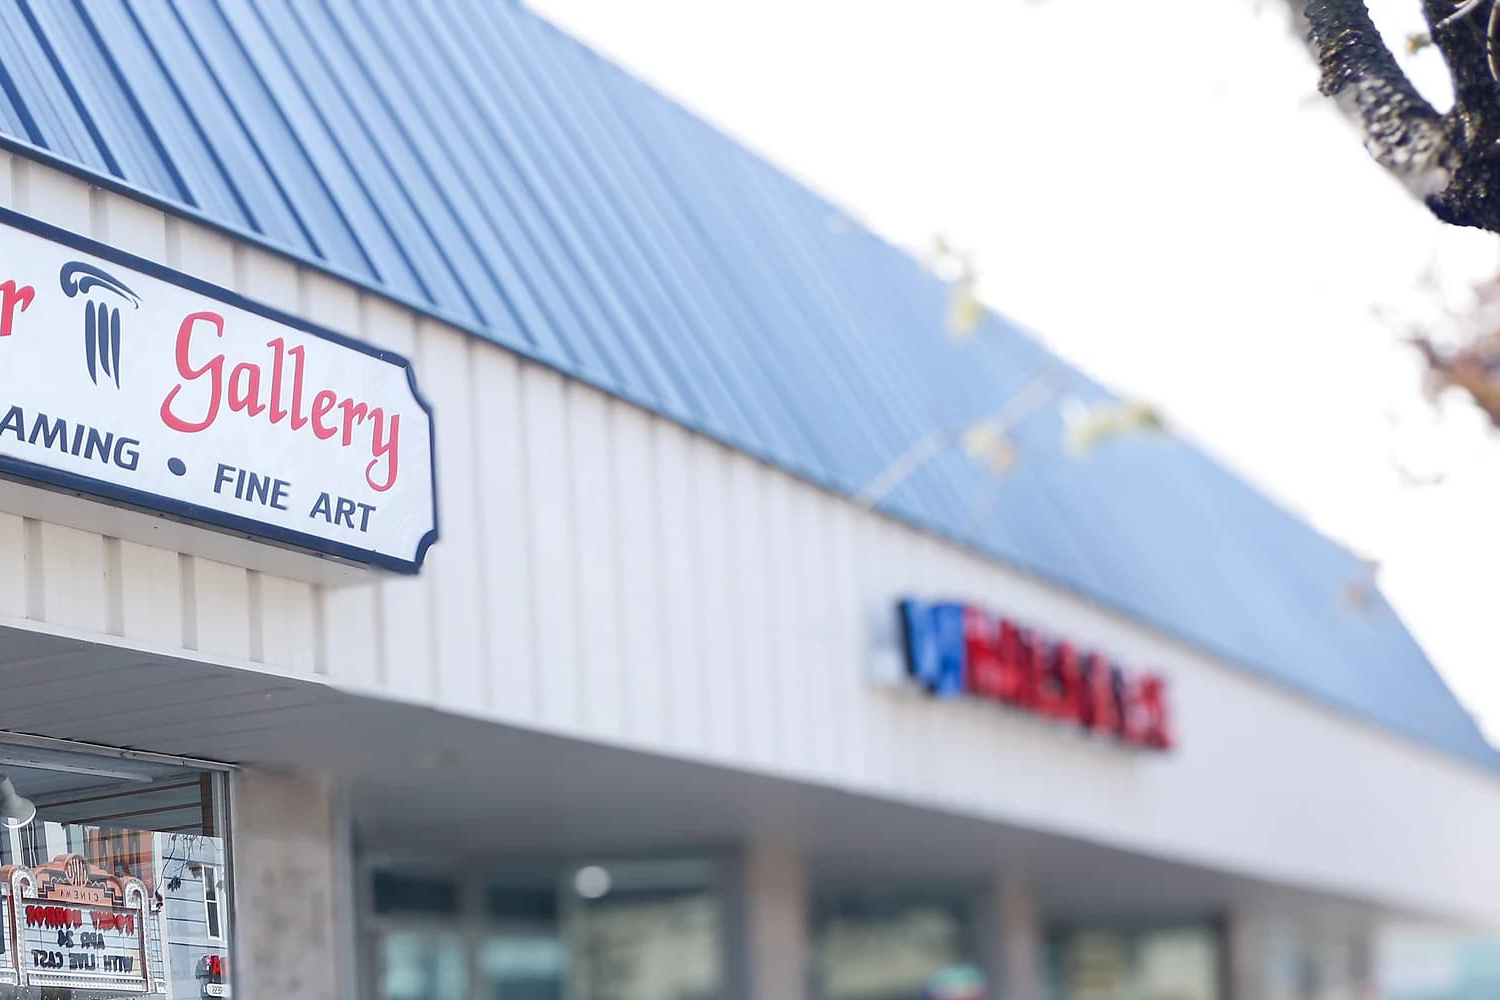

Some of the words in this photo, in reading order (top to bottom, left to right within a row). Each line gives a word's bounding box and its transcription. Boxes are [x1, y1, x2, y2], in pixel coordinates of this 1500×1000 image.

[160, 311, 400, 492] Gallery
[213, 463, 291, 511] FINE
[309, 491, 377, 533] ART
